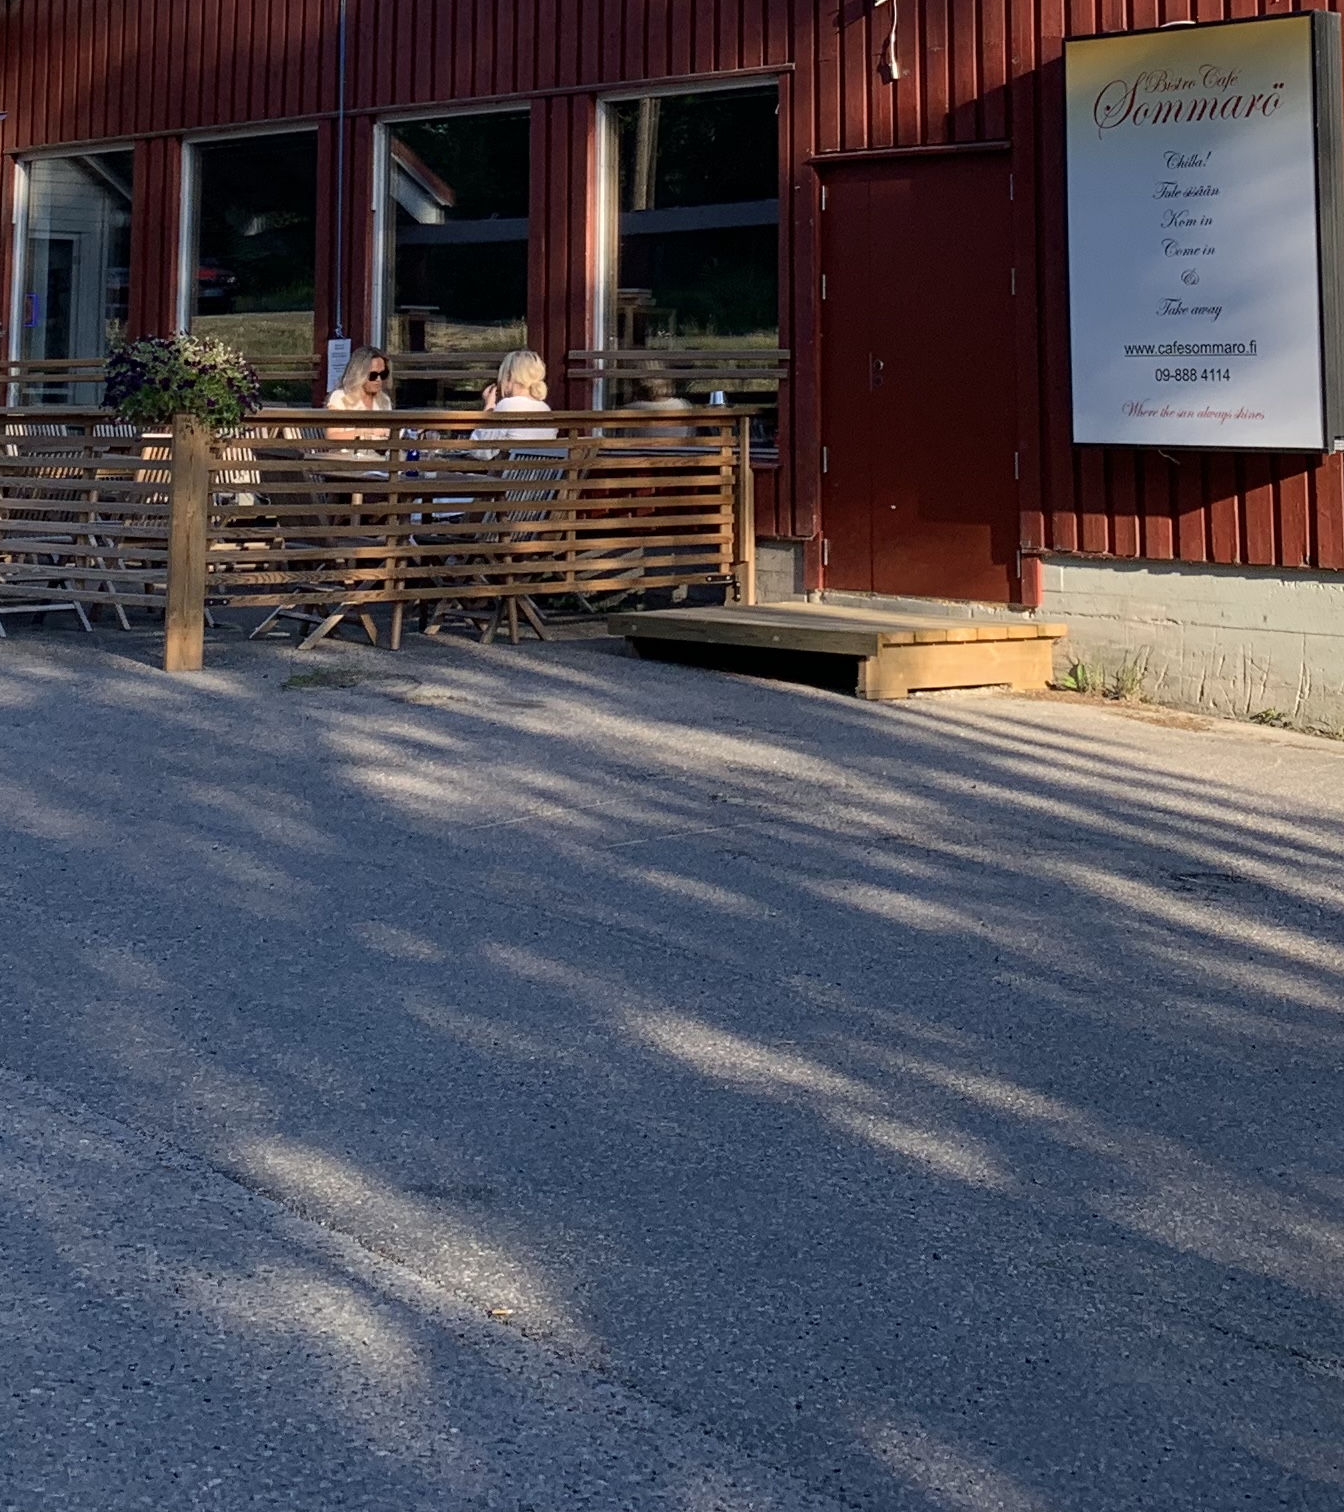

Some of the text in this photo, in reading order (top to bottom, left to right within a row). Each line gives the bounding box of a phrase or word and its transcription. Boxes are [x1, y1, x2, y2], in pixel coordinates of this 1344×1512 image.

[1145, 64, 1242, 94] Bistro Café
[1093, 71, 1284, 140] Sommarö
[1163, 150, 1212, 170] Chilla!
[1152, 181, 1182, 200] Tule
[1160, 209, 1213, 229] Kom in
[1161, 238, 1215, 257] Come in
[1156, 297, 1223, 323] Take away
[1124, 339, 1257, 357] www.cafesommaro.fi
[1155, 368, 1231, 382] 09-888 4114
[1122, 398, 1158, 418] Where
[1160, 404, 1176, 418] the
[1197, 405, 1232, 425] always
